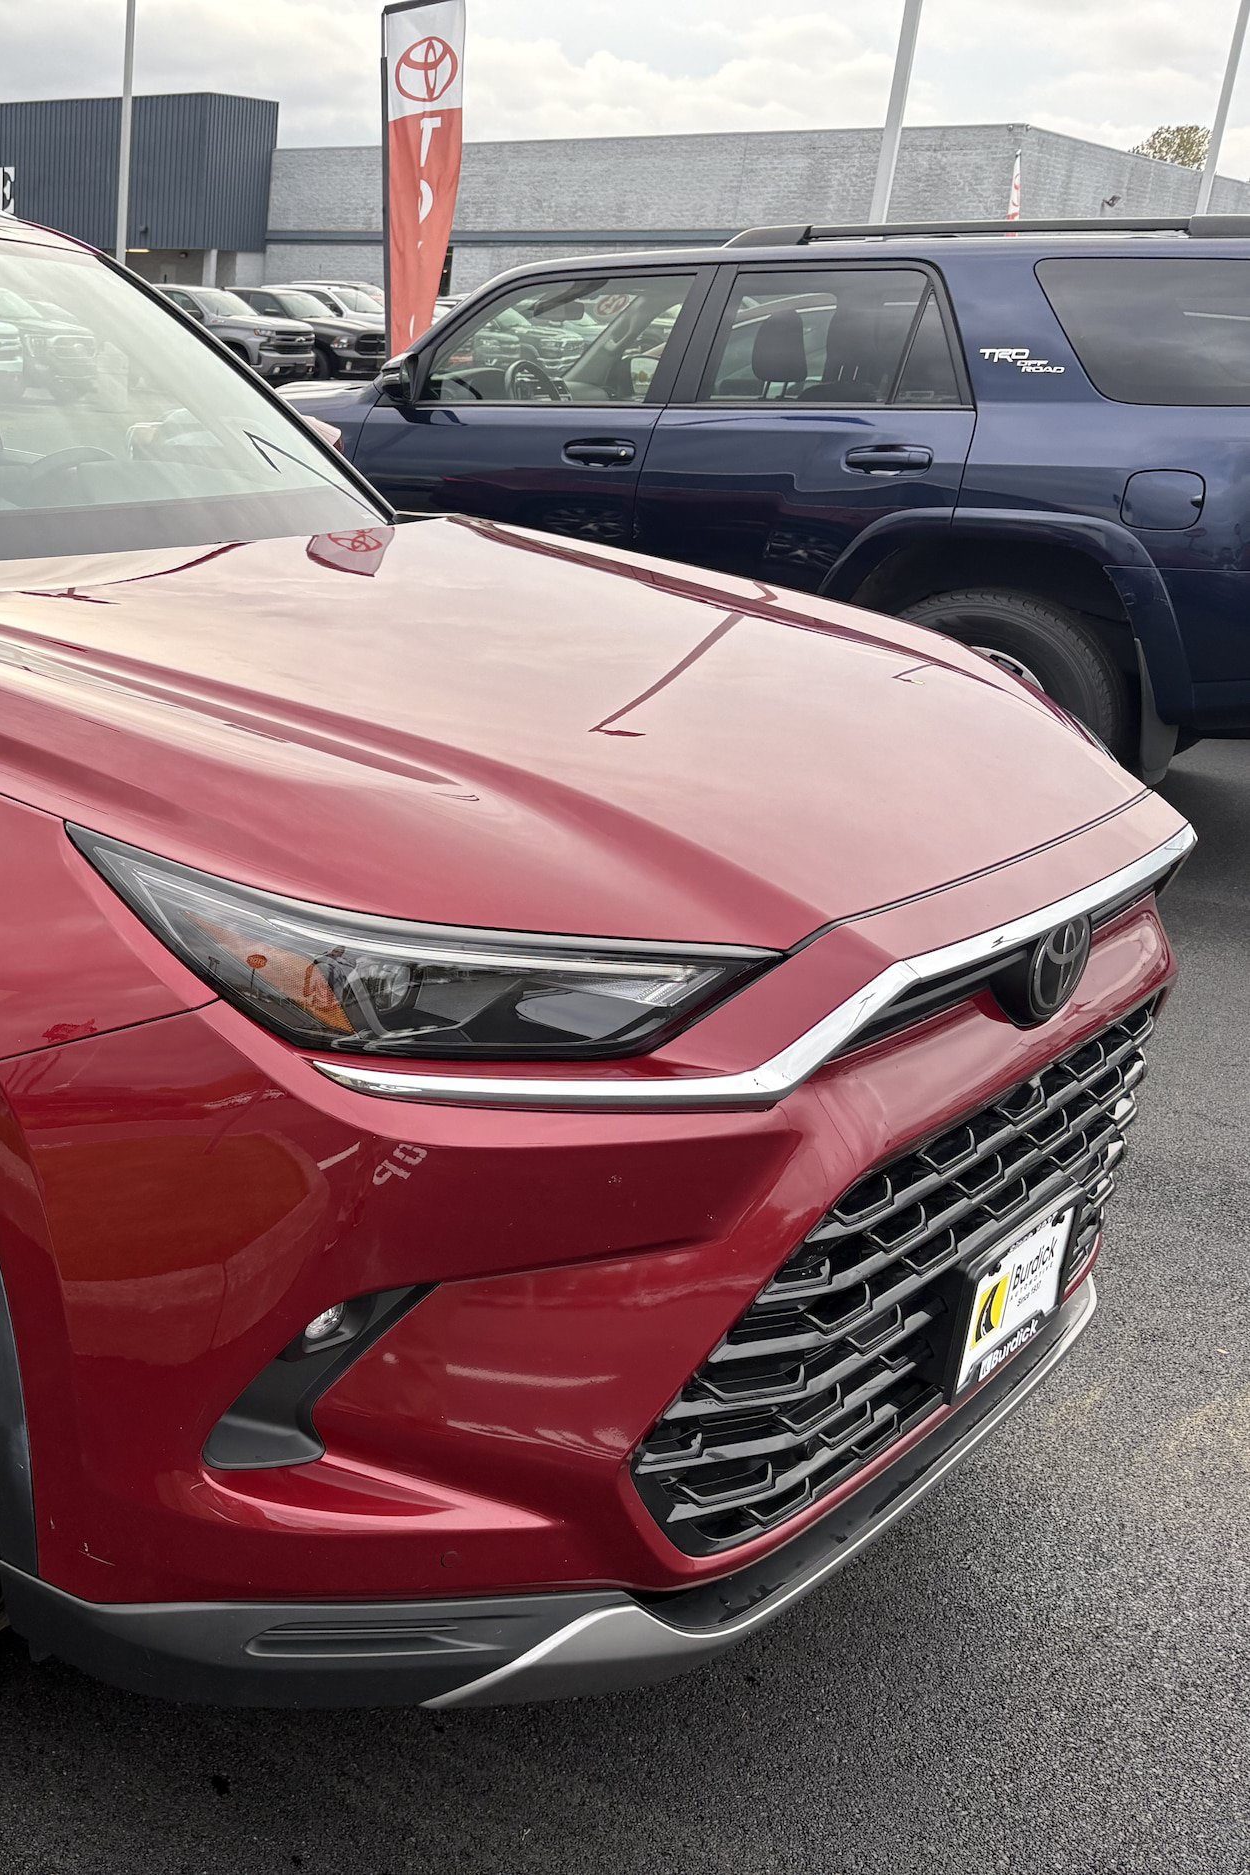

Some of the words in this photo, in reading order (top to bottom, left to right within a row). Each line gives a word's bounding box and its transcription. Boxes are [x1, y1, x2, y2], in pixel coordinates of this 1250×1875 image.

[1021, 366, 1065, 374] ROAD
[1012, 1235, 1058, 1291] Burdick
[990, 1318, 1039, 1371] Burdick
